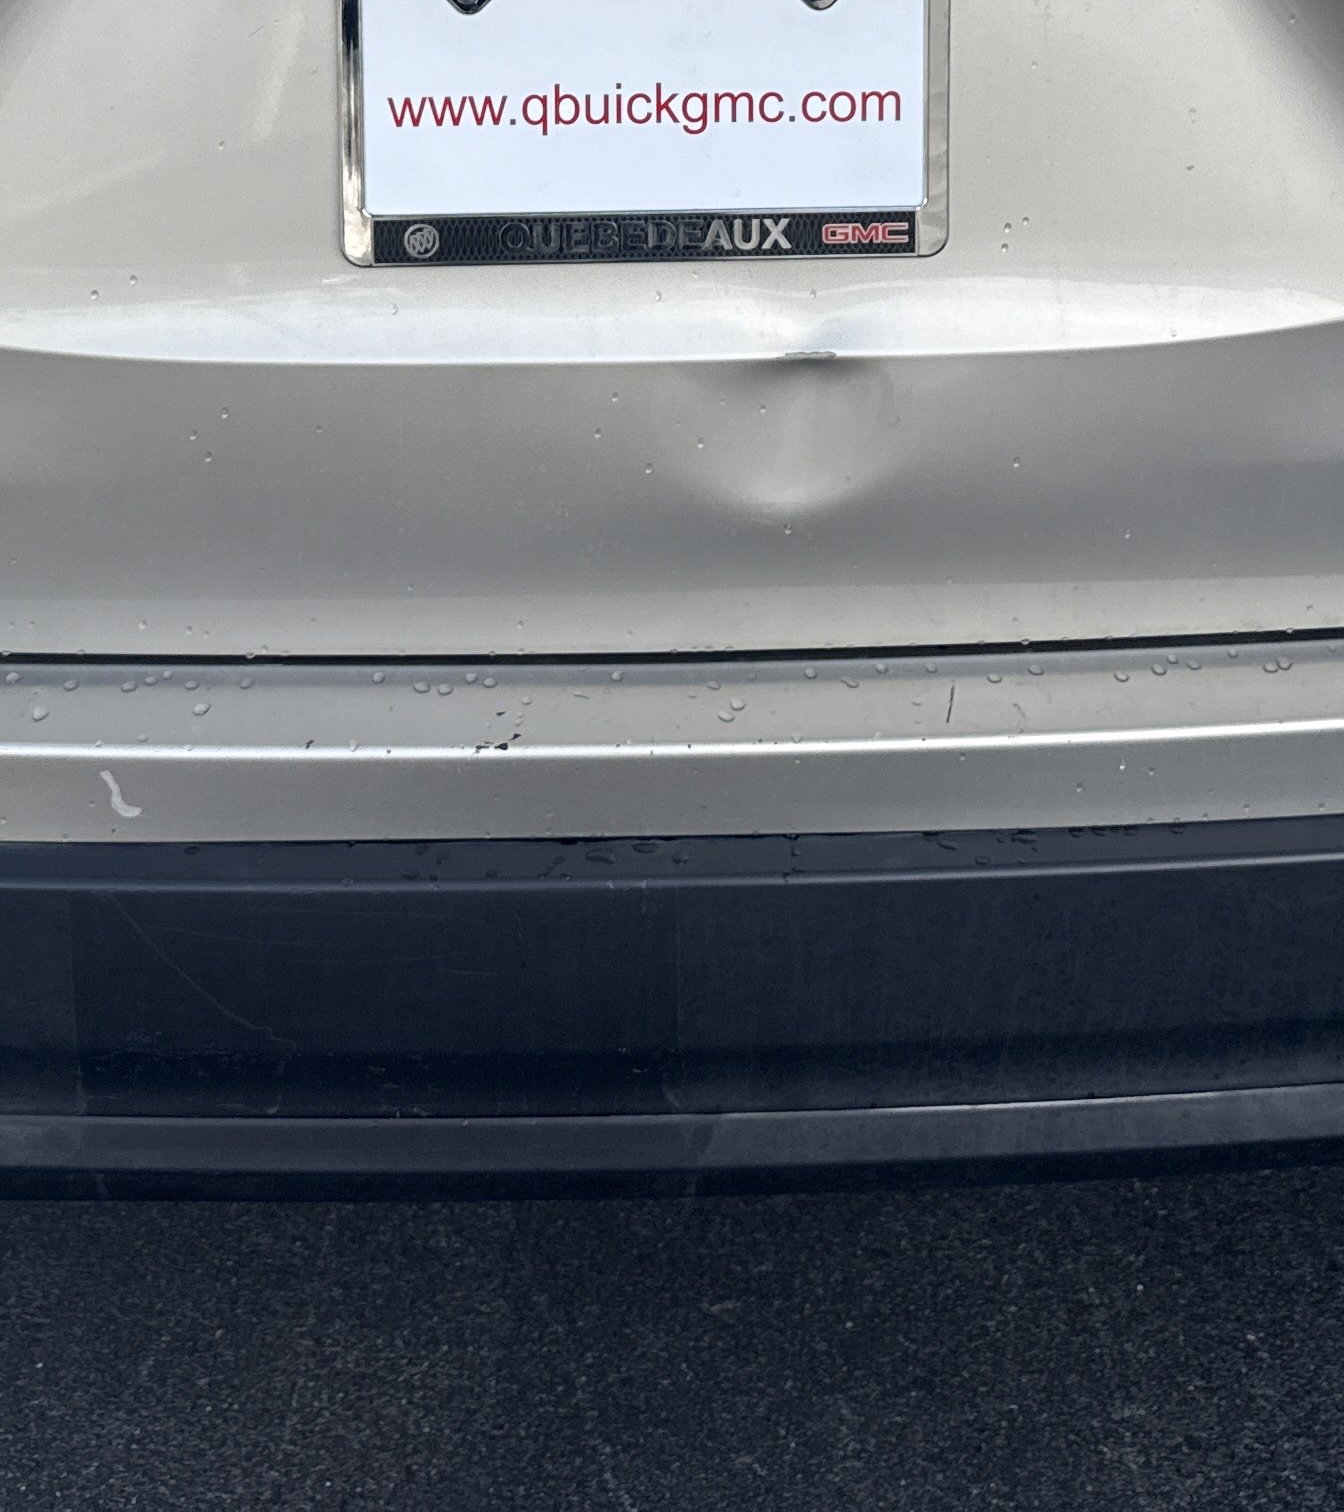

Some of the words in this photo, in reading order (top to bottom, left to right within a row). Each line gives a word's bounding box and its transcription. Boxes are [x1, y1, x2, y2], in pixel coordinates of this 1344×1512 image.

[387, 82, 902, 136] www.qbuickgmc.com
[498, 217, 792, 254] QUEBEDEAUX
[822, 221, 910, 245] GMC
